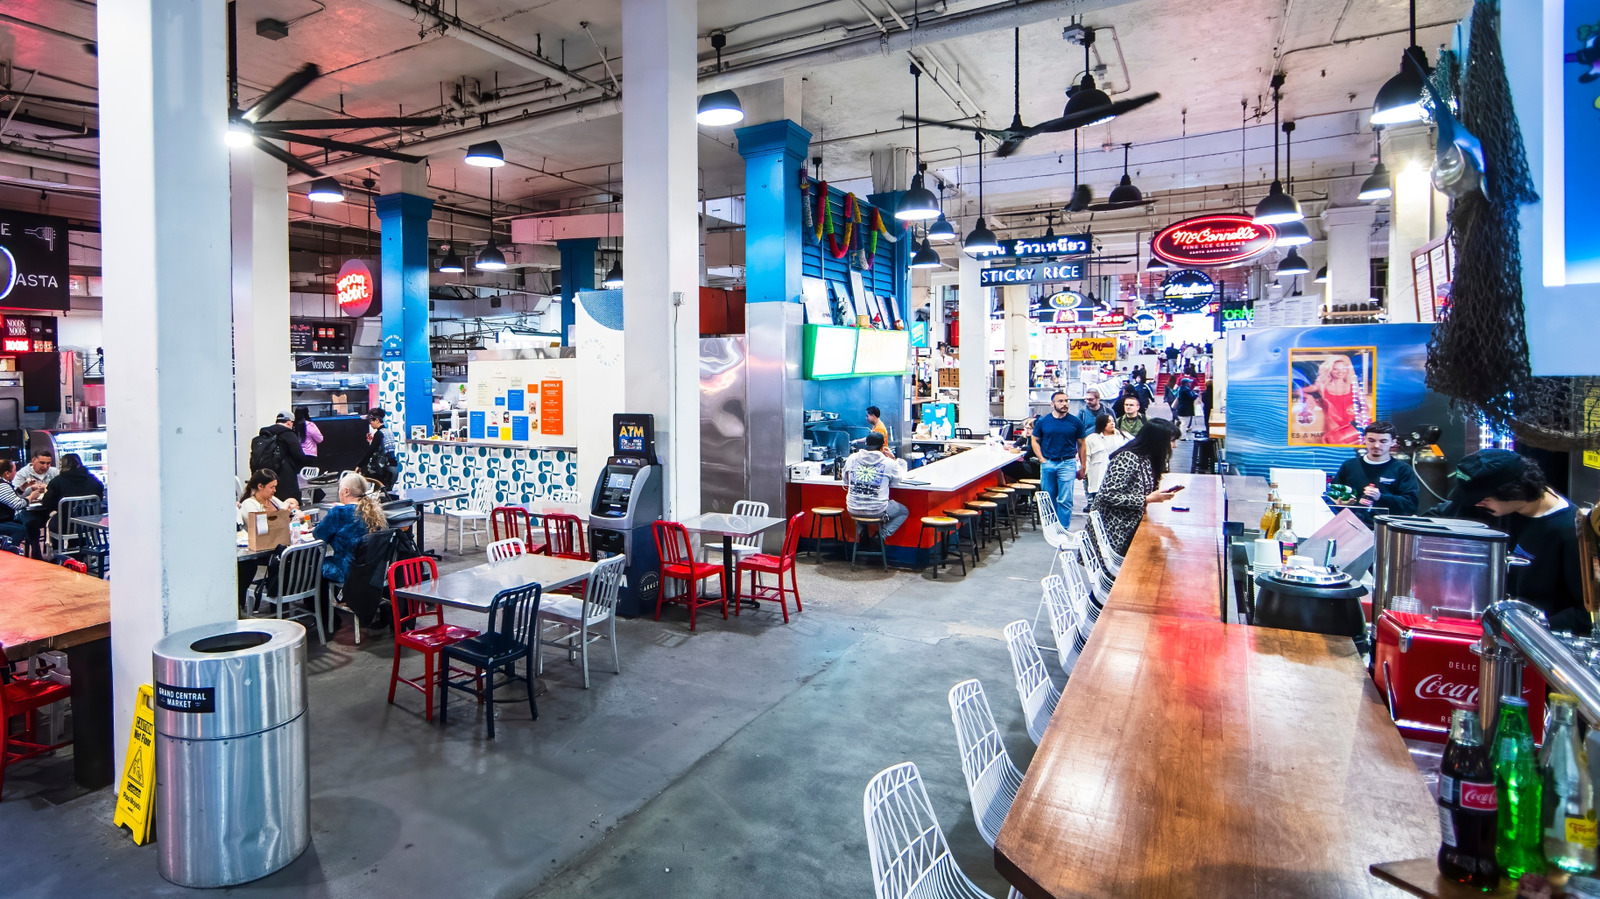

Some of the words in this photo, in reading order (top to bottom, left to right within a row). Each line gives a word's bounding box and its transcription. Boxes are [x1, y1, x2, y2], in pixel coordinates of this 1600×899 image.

[1173, 227, 1258, 244] McConnell's
[1216, 240, 1246, 248] CREAMS
[982, 268, 1033, 282] STICKY
[1043, 265, 1080, 279] RICE
[312, 361, 335, 370] WINGS
[618, 426, 644, 438] ATM
[1448, 660, 1477, 672] DELIC
[158, 687, 175, 699] GRAND
[175, 691, 207, 701] CENTRAL
[167, 698, 191, 708] MARKET
[141, 733, 152, 748] Floor
